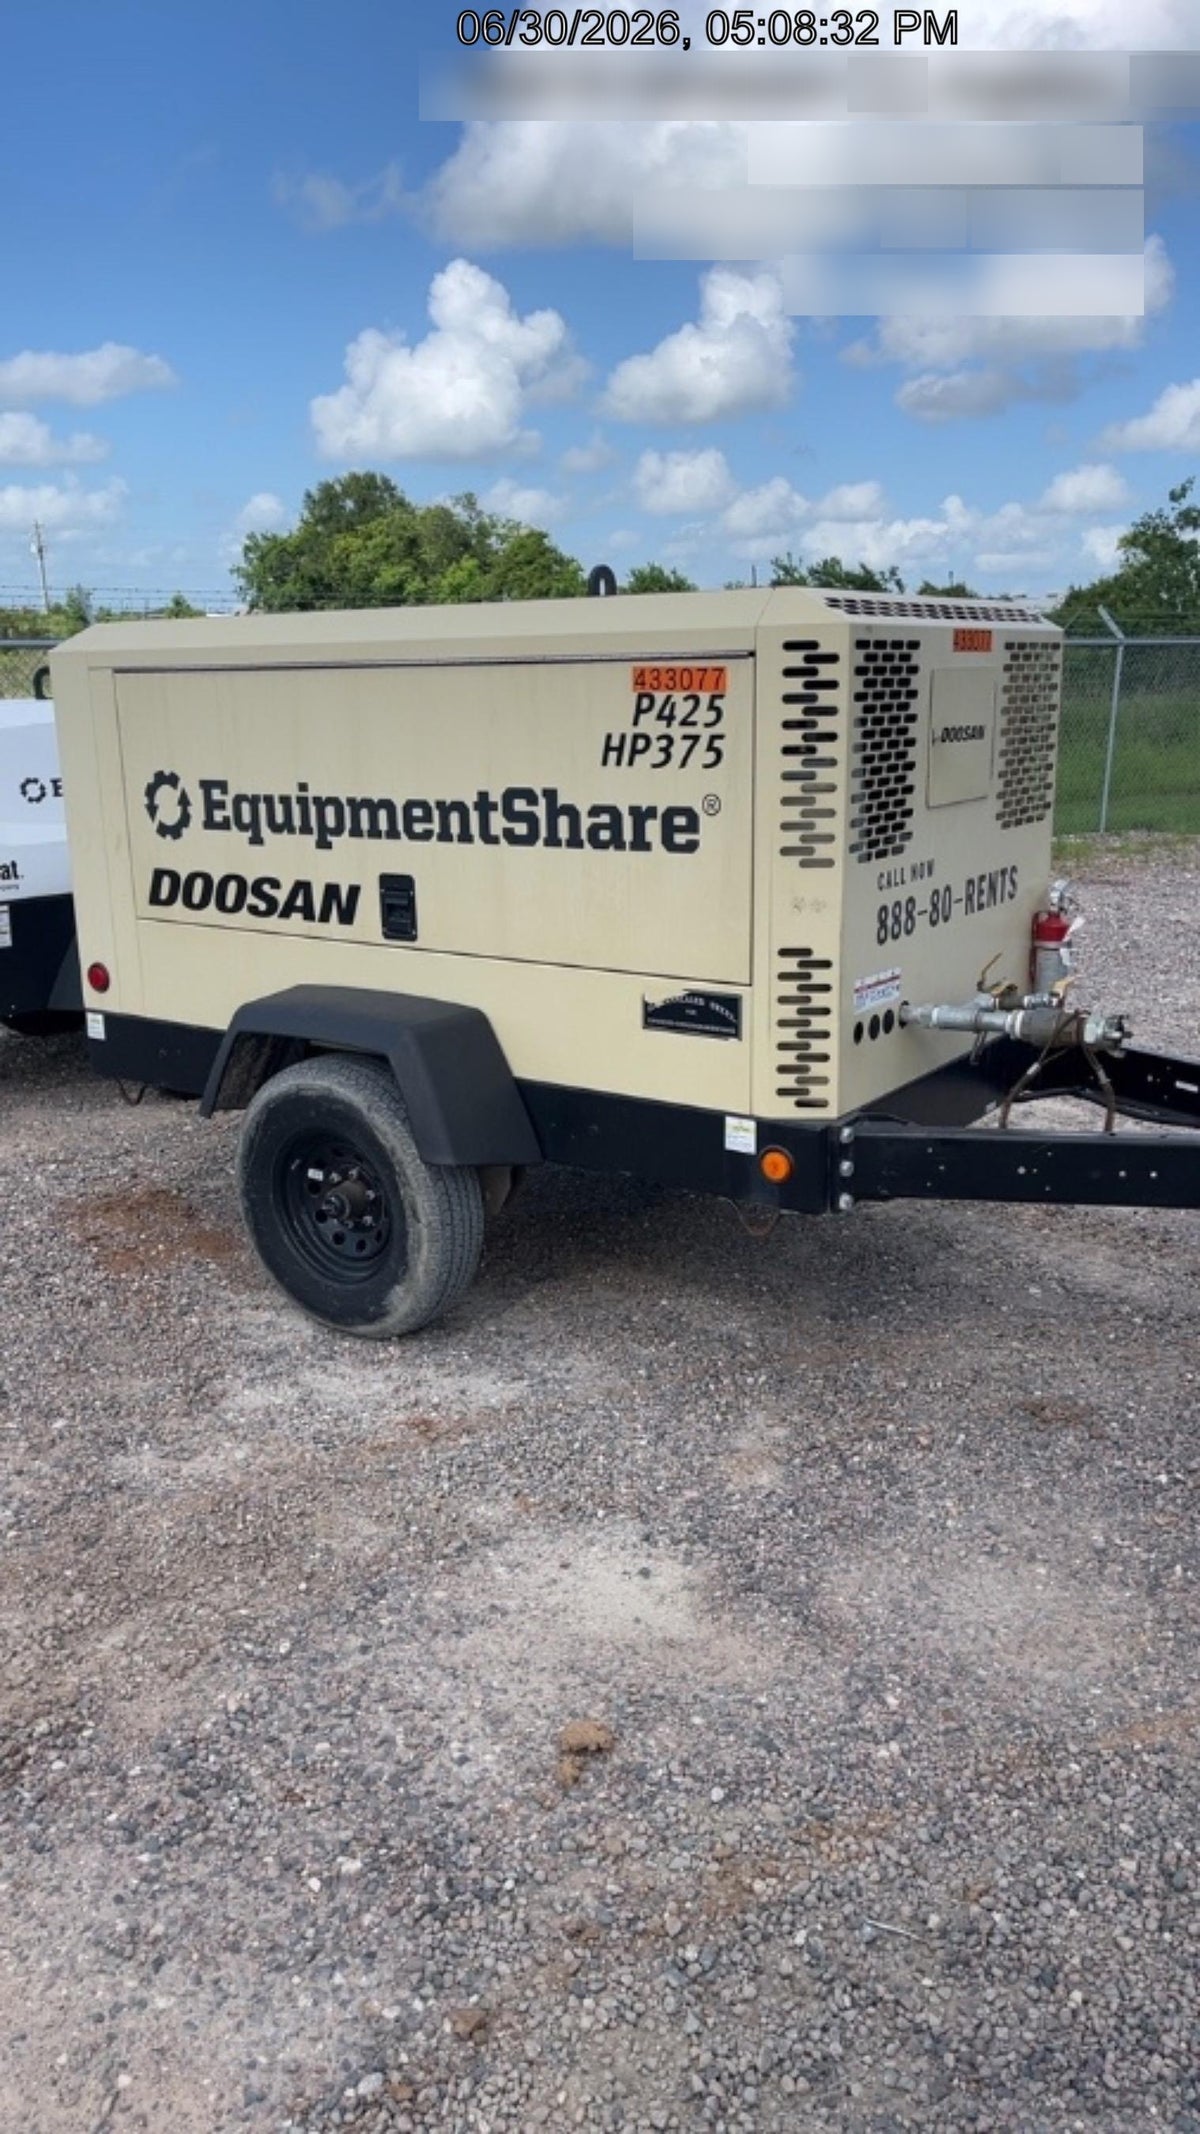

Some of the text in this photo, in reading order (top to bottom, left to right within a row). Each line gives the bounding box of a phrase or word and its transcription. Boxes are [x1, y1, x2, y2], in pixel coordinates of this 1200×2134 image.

[634, 667, 725, 691] 433077
[632, 692, 726, 728] P425
[601, 732, 726, 769] HP375
[941, 724, 986, 742] DOOSAN
[877, 859, 935, 891] CALL NOW
[149, 867, 362, 925] DOOSAN
[876, 864, 1018, 946] 888-80-RENTS
